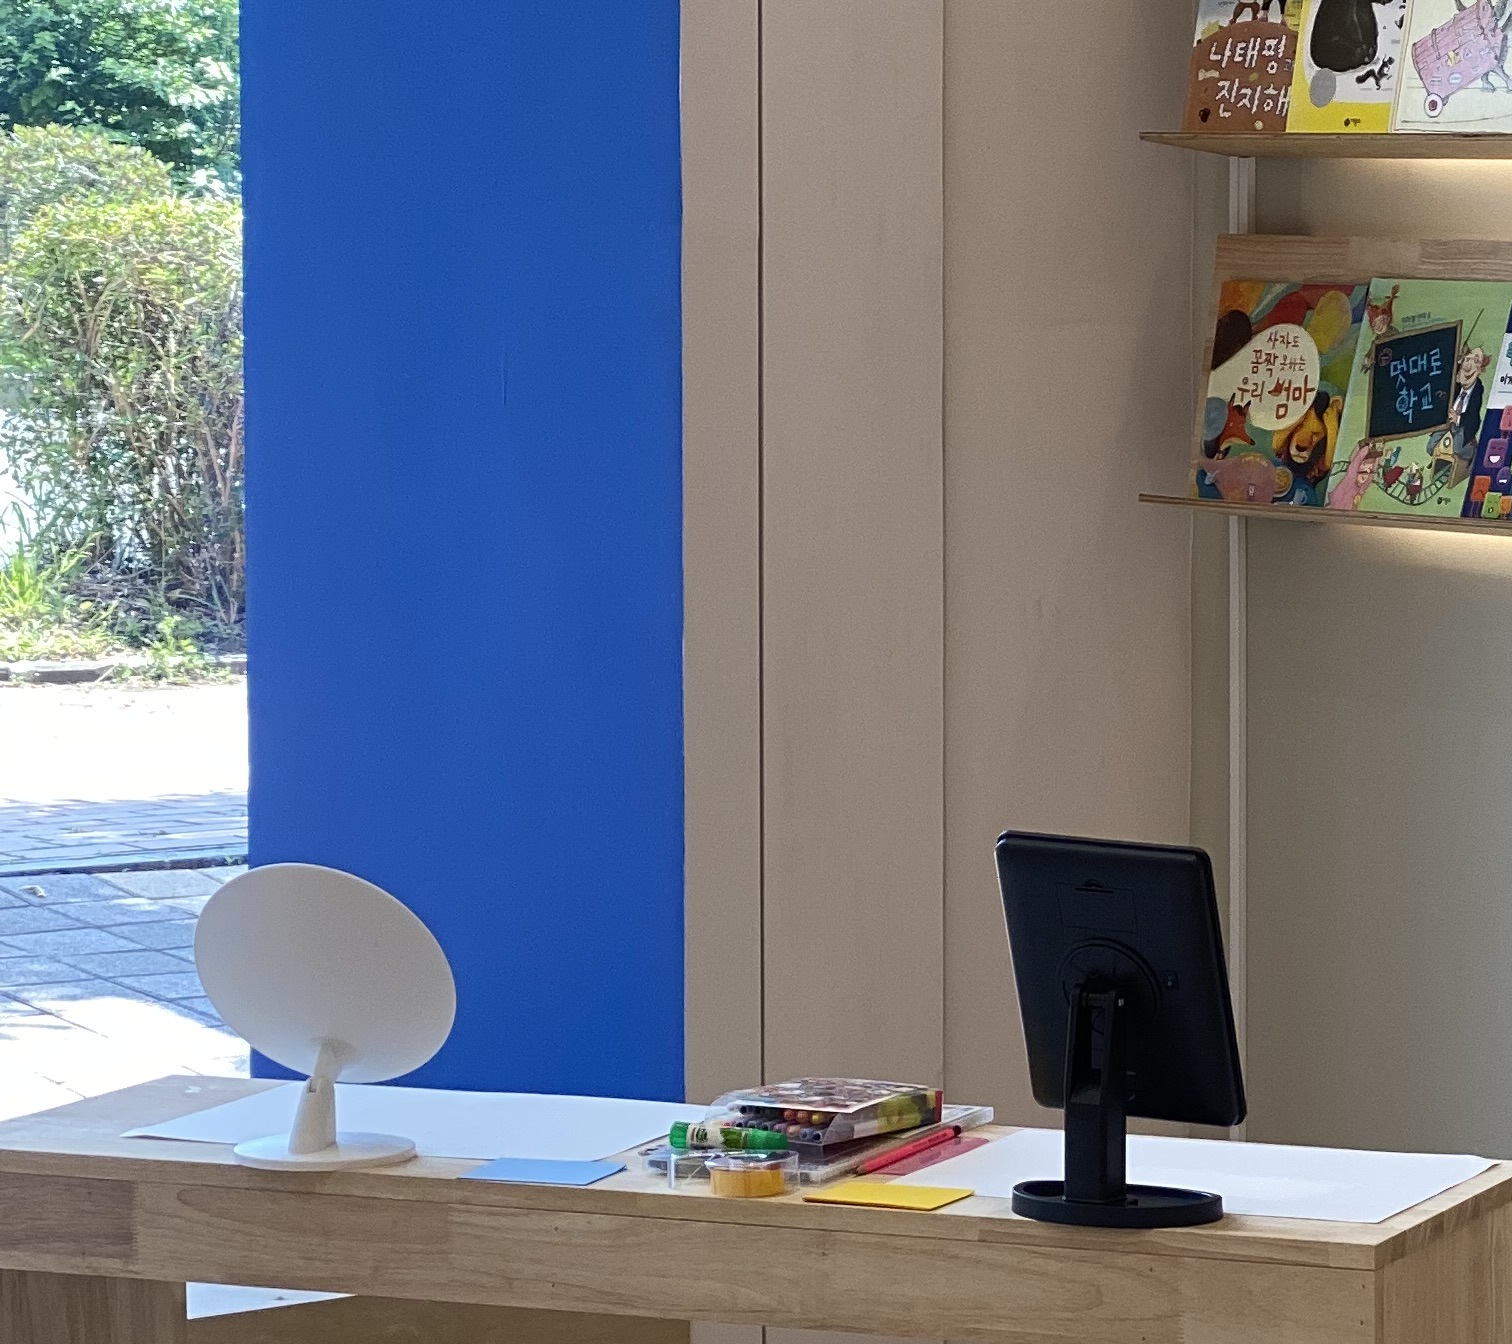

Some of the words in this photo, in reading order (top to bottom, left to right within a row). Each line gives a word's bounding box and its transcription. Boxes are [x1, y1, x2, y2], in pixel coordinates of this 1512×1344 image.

[1215, 78, 1292, 117] 진지해
[1266, 330, 1300, 349] 사자도
[1251, 349, 1279, 378] 꼼짝
[1390, 347, 1442, 388] 멋대로
[1237, 377, 1265, 403] 우리
[1396, 382, 1434, 423] 학교
